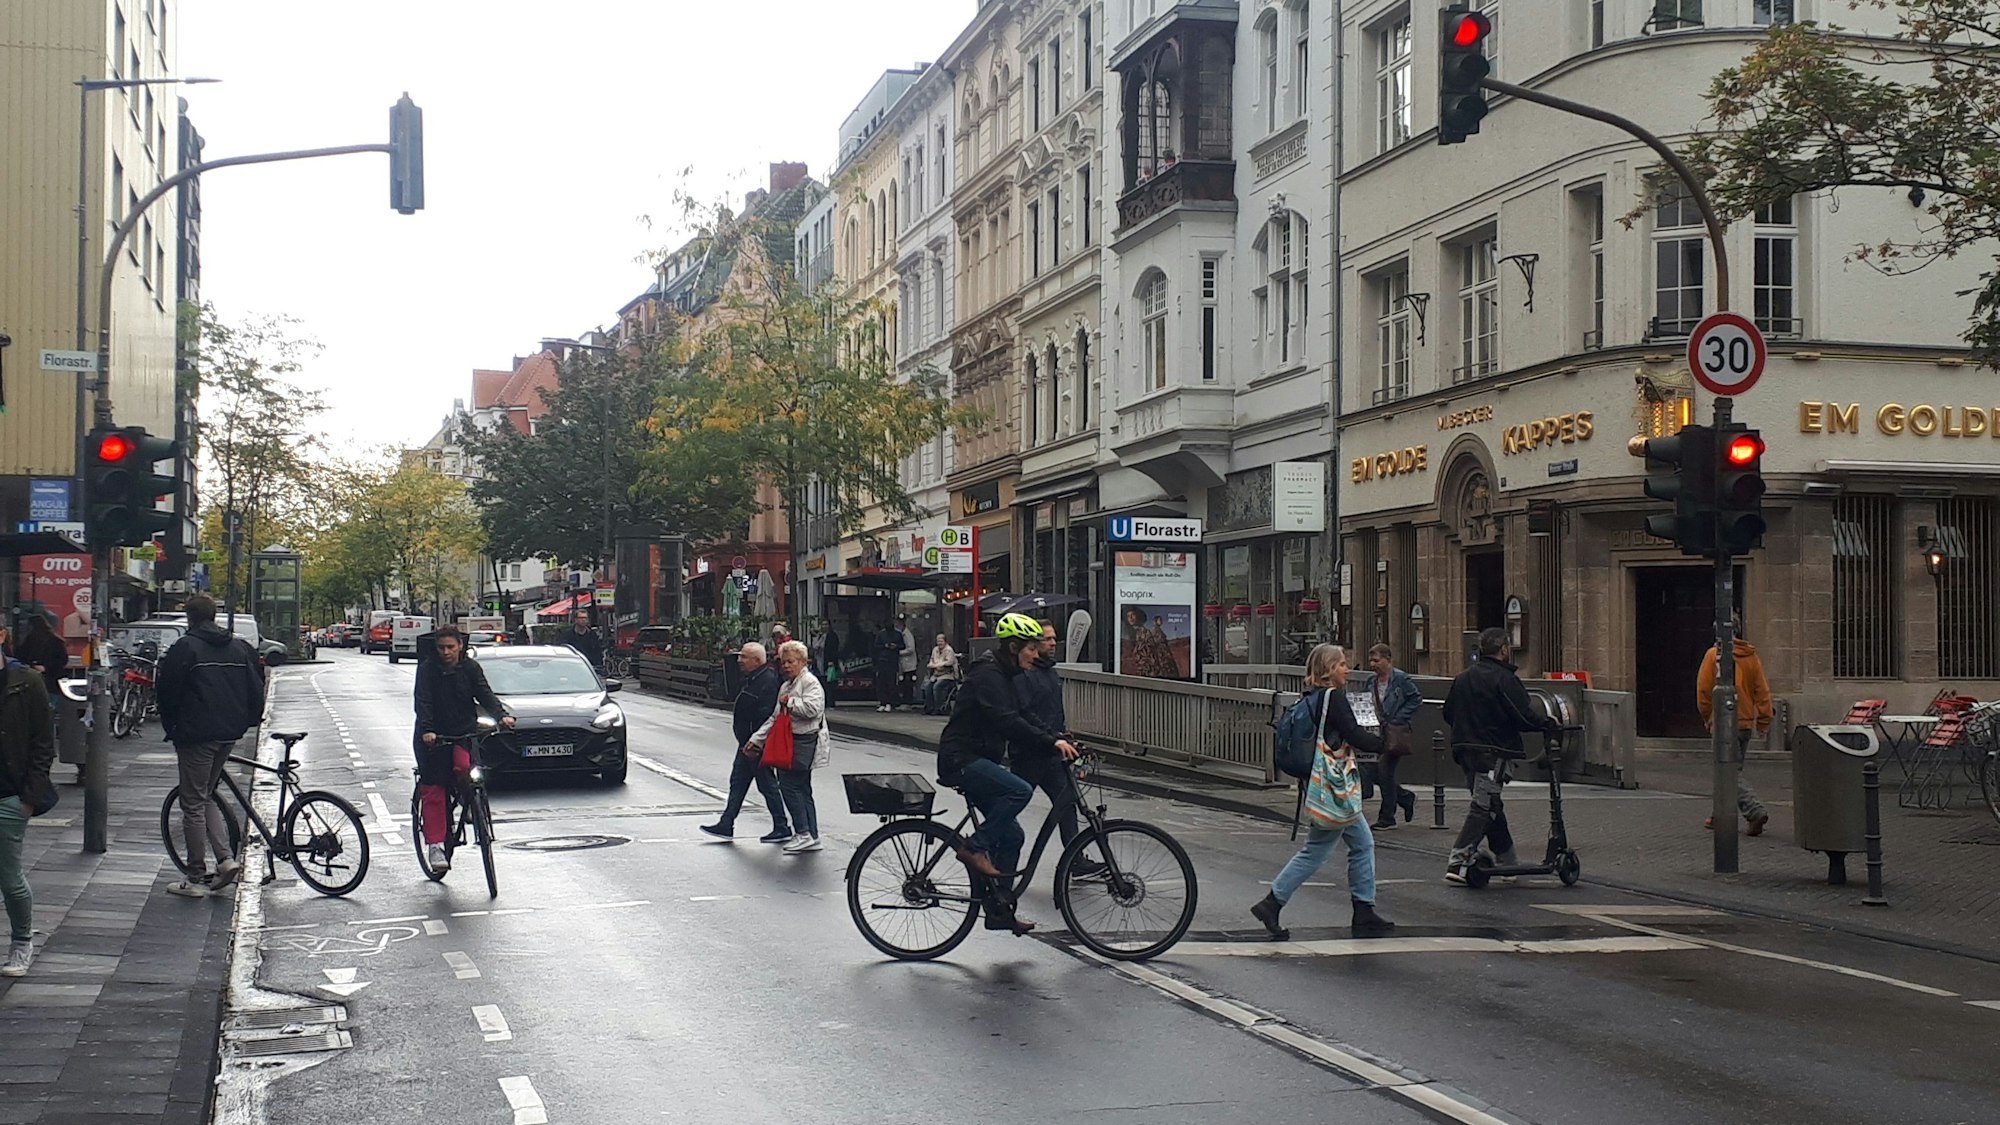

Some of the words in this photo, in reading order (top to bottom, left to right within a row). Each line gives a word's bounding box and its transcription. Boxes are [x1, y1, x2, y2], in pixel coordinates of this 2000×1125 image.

[43, 352, 92, 368] Florastr.
[1704, 336, 1749, 374] 30
[1801, 401, 1860, 434] EM
[1502, 410, 1594, 456] KAPPES
[1376, 443, 1427, 480] GOLDE
[31, 509, 68, 518] COFFEE
[1112, 519, 1128, 538] U
[1135, 522, 1199, 537] Florastr.
[960, 533, 969, 545] B
[43, 558, 81, 570] OTTO
[29, 576, 53, 585] Sofa,
[551, 745, 572, 755] 1430
